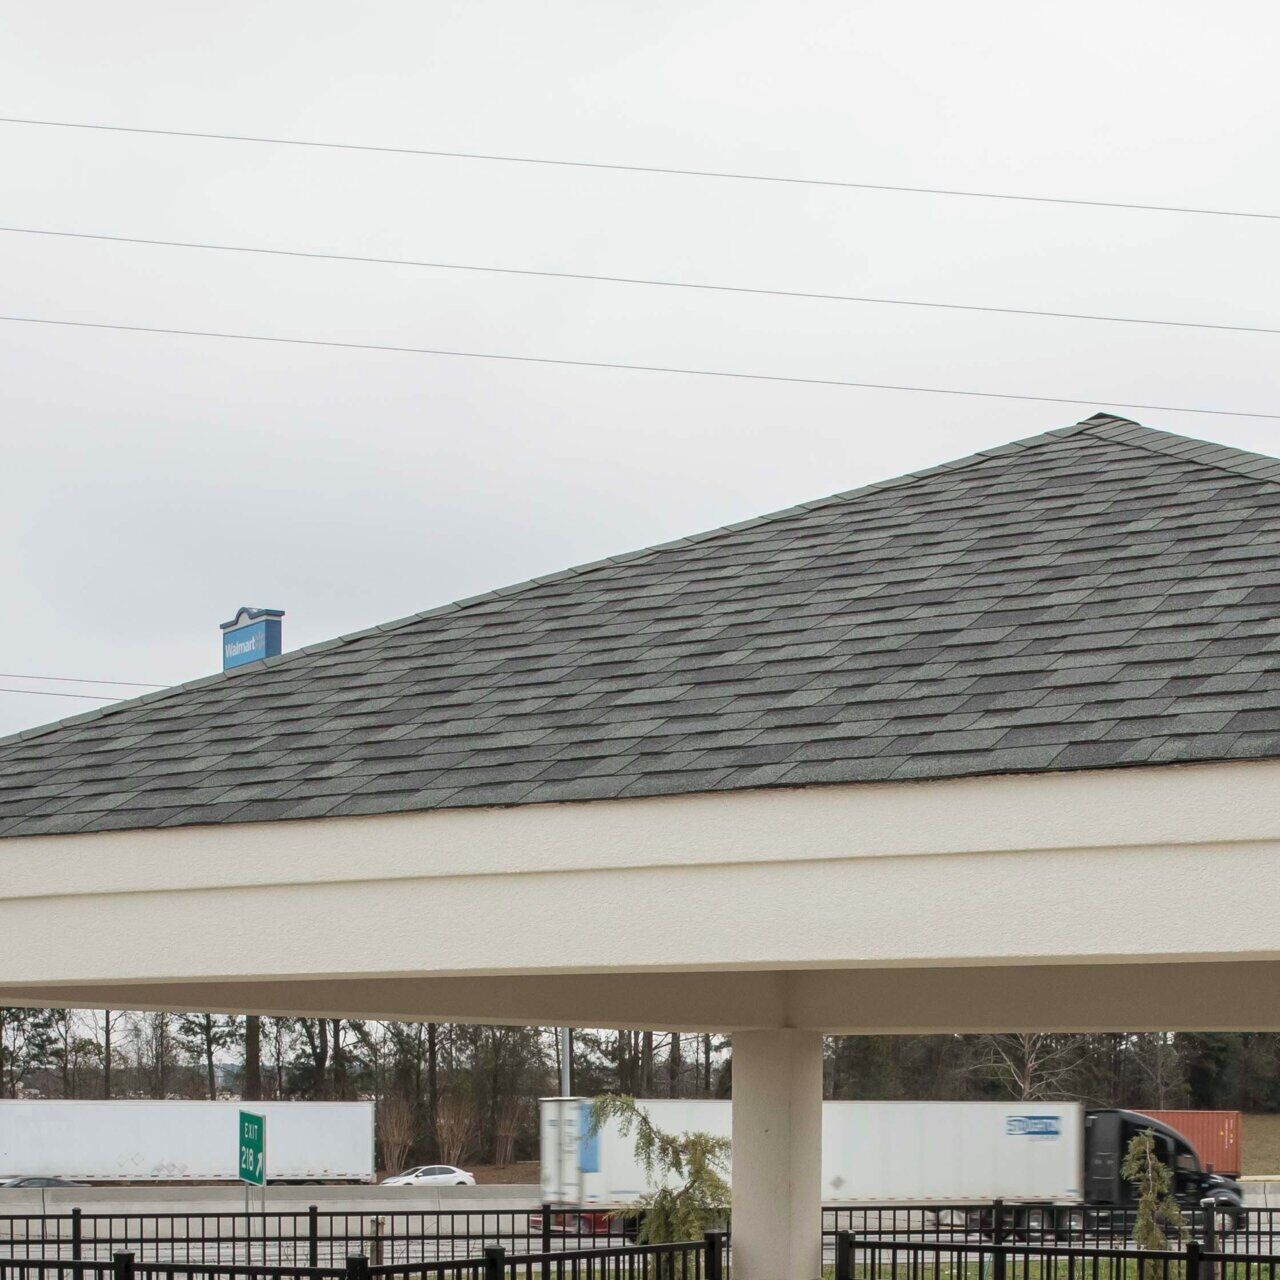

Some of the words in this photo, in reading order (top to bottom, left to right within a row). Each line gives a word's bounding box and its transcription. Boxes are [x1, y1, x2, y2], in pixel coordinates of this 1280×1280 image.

[225, 637, 255, 658] Walmart
[244, 1122, 258, 1140] EXIT
[241, 1146, 254, 1171] 218
